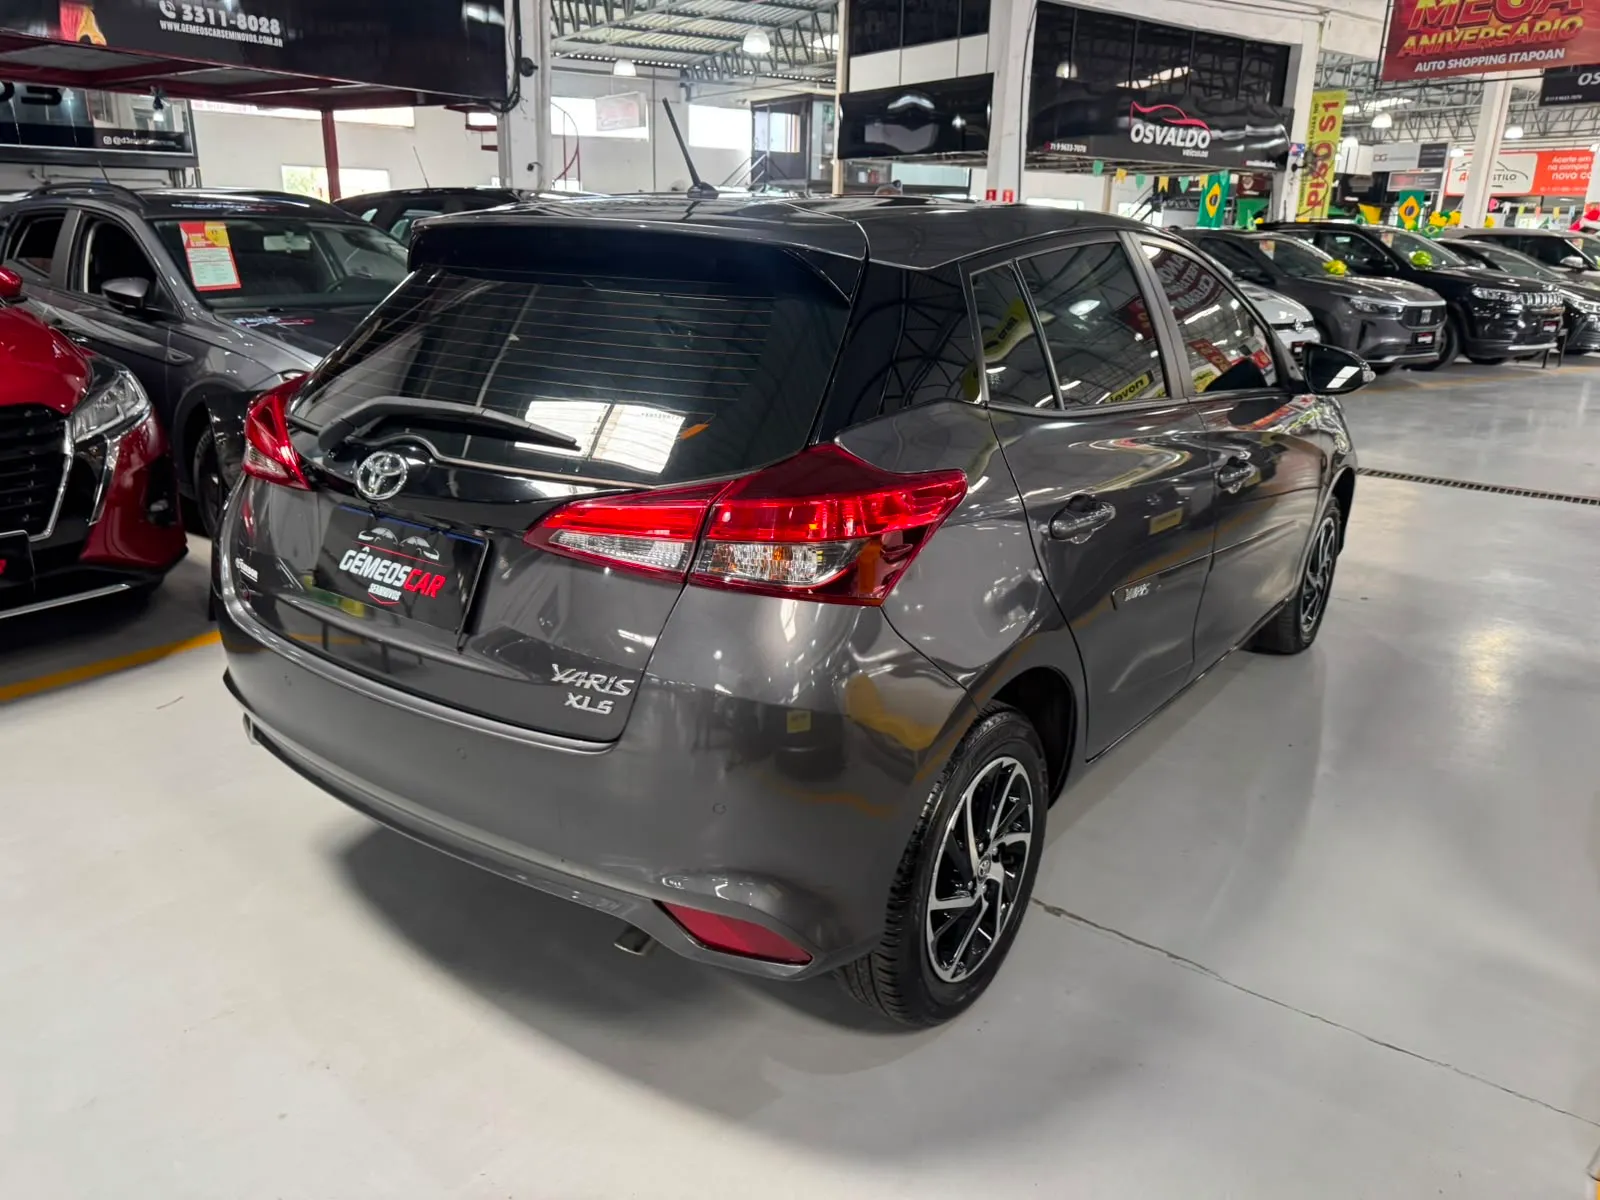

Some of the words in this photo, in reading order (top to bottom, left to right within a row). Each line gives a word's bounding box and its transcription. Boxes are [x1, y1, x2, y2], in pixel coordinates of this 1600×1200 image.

[181, 4, 280, 35] 3311-8028
[1397, 15, 1584, 57] ANIVERSÁRIO
[1414, 60, 1446, 73] AUTO
[1447, 52, 1506, 70] SHOPPING
[1508, 48, 1566, 65] ITAPOAN
[1319, 101, 1340, 132] S1
[1130, 123, 1211, 149] OSVALDO
[1306, 142, 1333, 208] PISO
[1551, 171, 1578, 180] novo
[551, 663, 635, 696] YARIS
[564, 692, 615, 715] XLS
